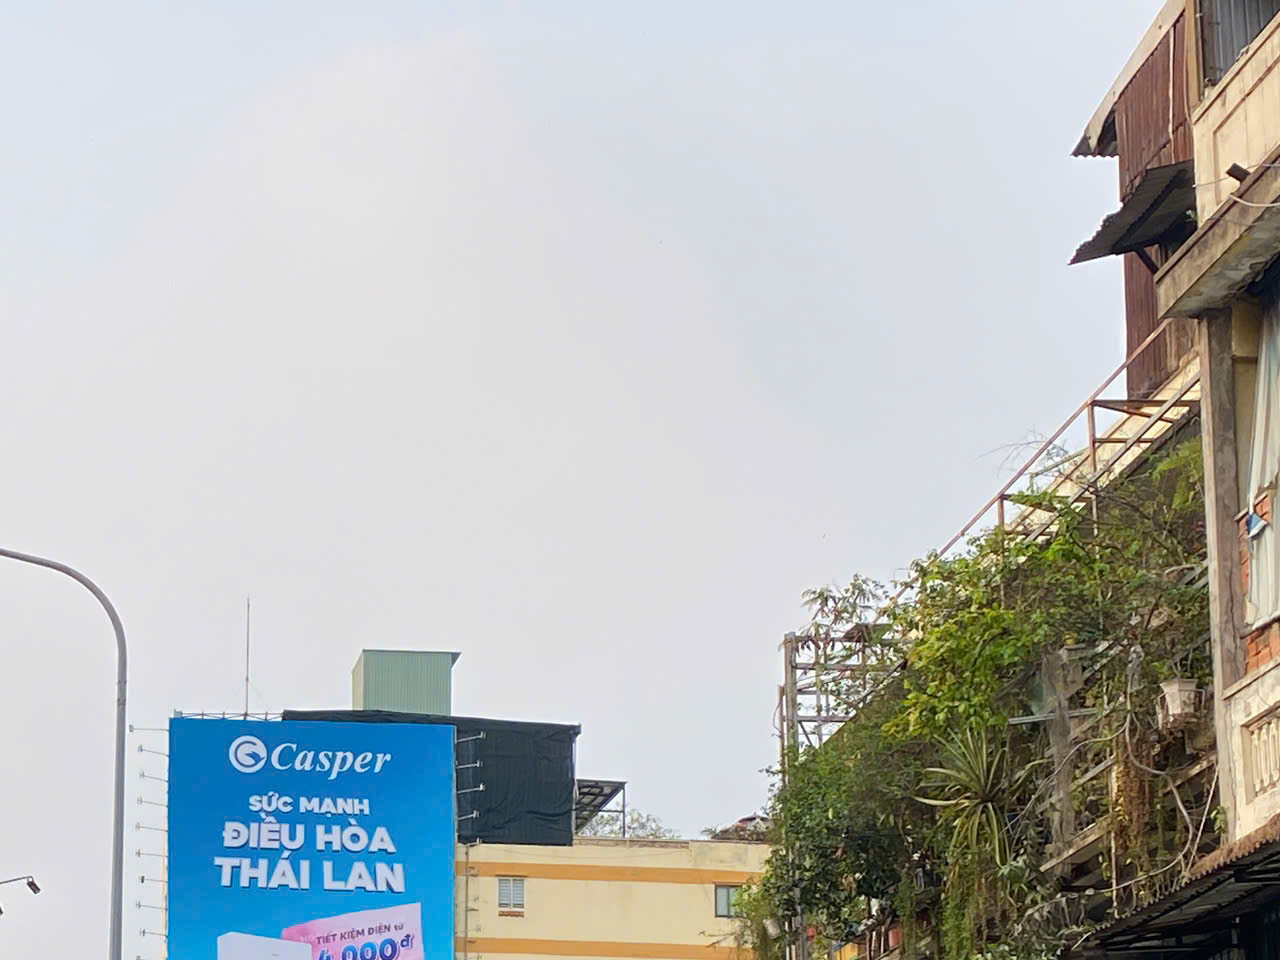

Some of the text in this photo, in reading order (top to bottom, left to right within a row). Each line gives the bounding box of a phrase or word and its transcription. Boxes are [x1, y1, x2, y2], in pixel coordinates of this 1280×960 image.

[271, 743, 391, 780] Casper
[249, 791, 370, 817] SỨC MẠNH
[222, 812, 397, 854] ĐIỀU HÒA
[214, 850, 406, 892] THÁI LAN
[340, 928, 365, 941] KIỆM
[368, 923, 390, 936] ĐIỆN
